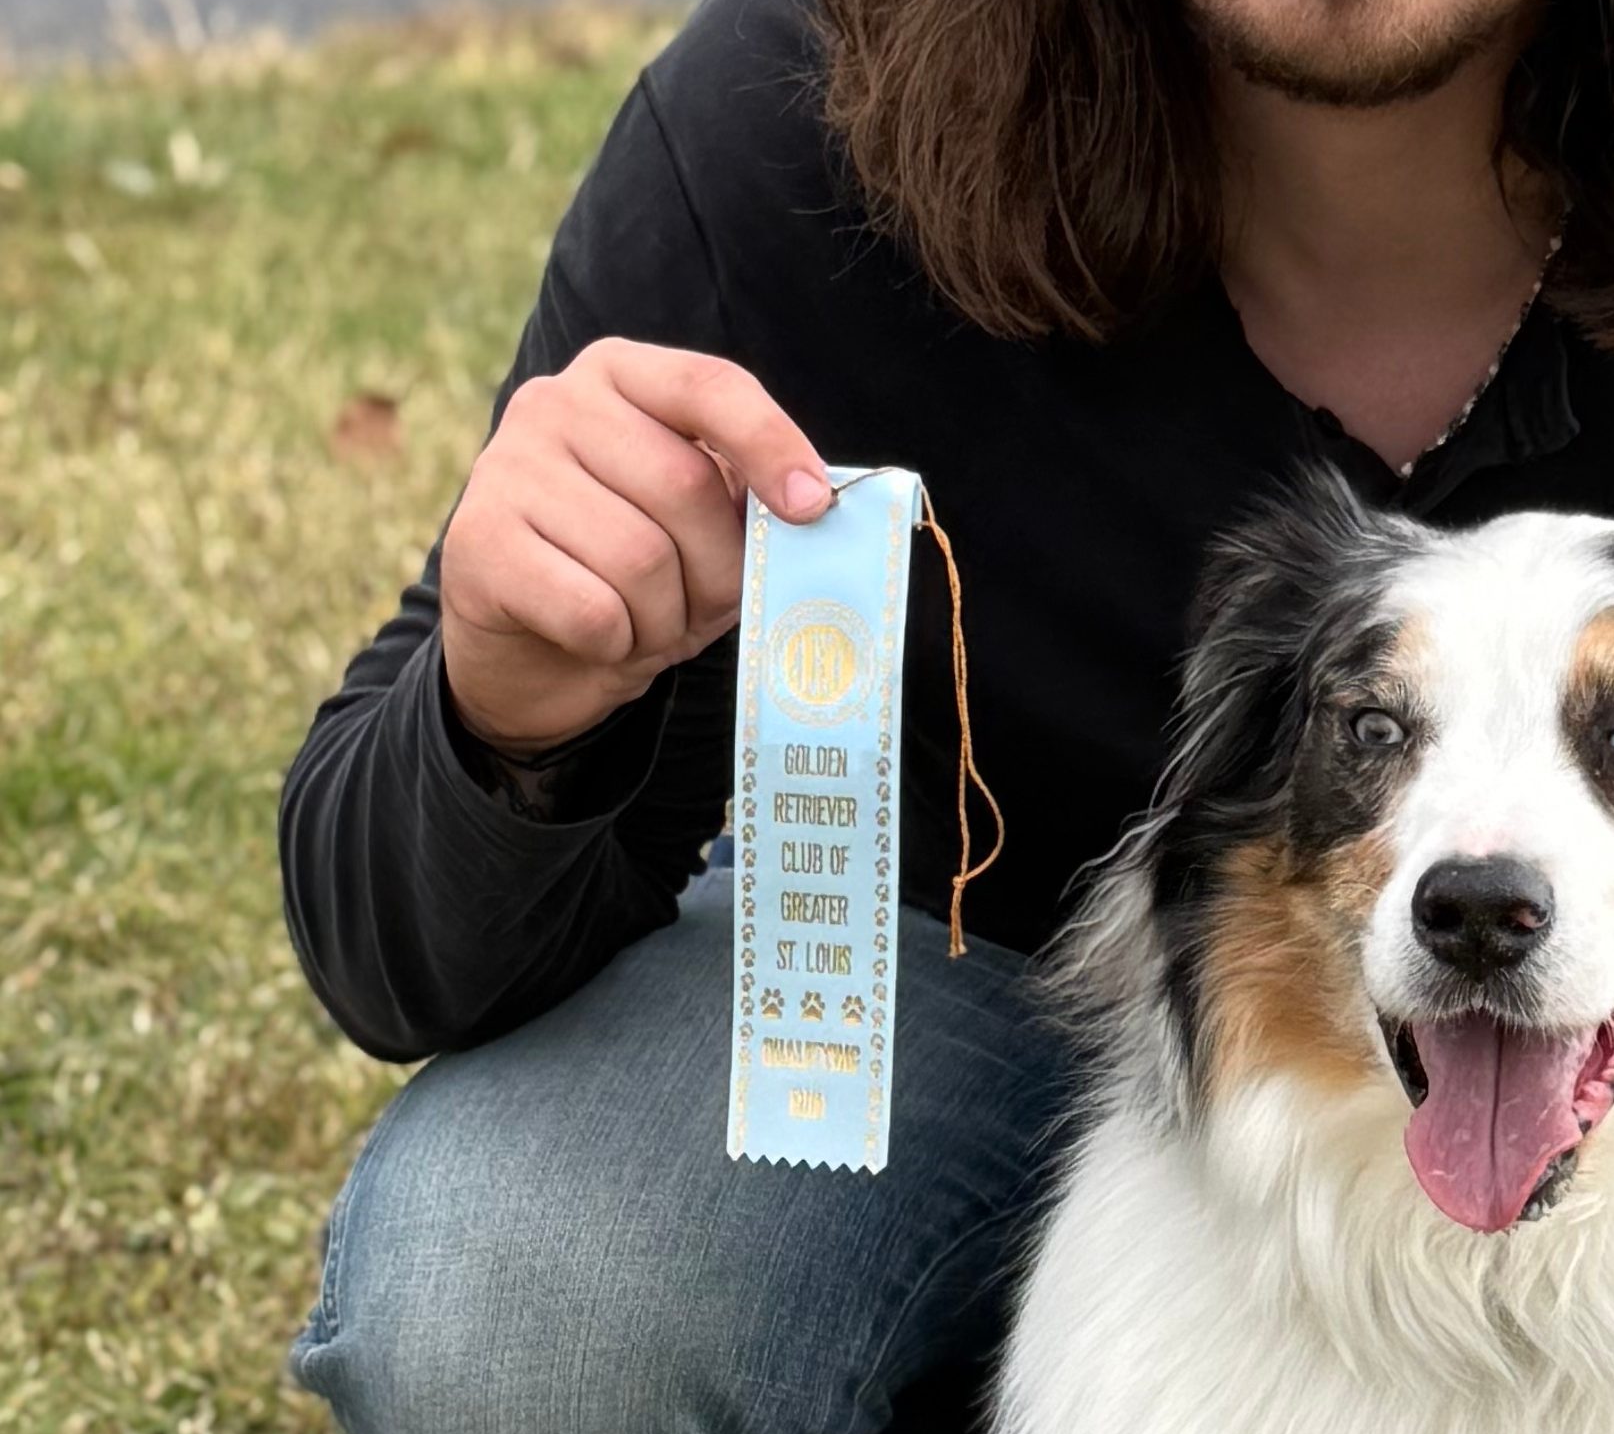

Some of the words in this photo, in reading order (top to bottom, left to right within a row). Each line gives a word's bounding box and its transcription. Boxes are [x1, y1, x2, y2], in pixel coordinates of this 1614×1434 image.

[784, 743, 848, 777] GOLDEN
[773, 792, 858, 827] RETRIEVER
[781, 841, 823, 874] CLUB
[830, 845, 850, 875] OF
[780, 891, 849, 926] GREATER
[776, 940, 800, 973] ST.
[806, 941, 853, 975] LOUIS
